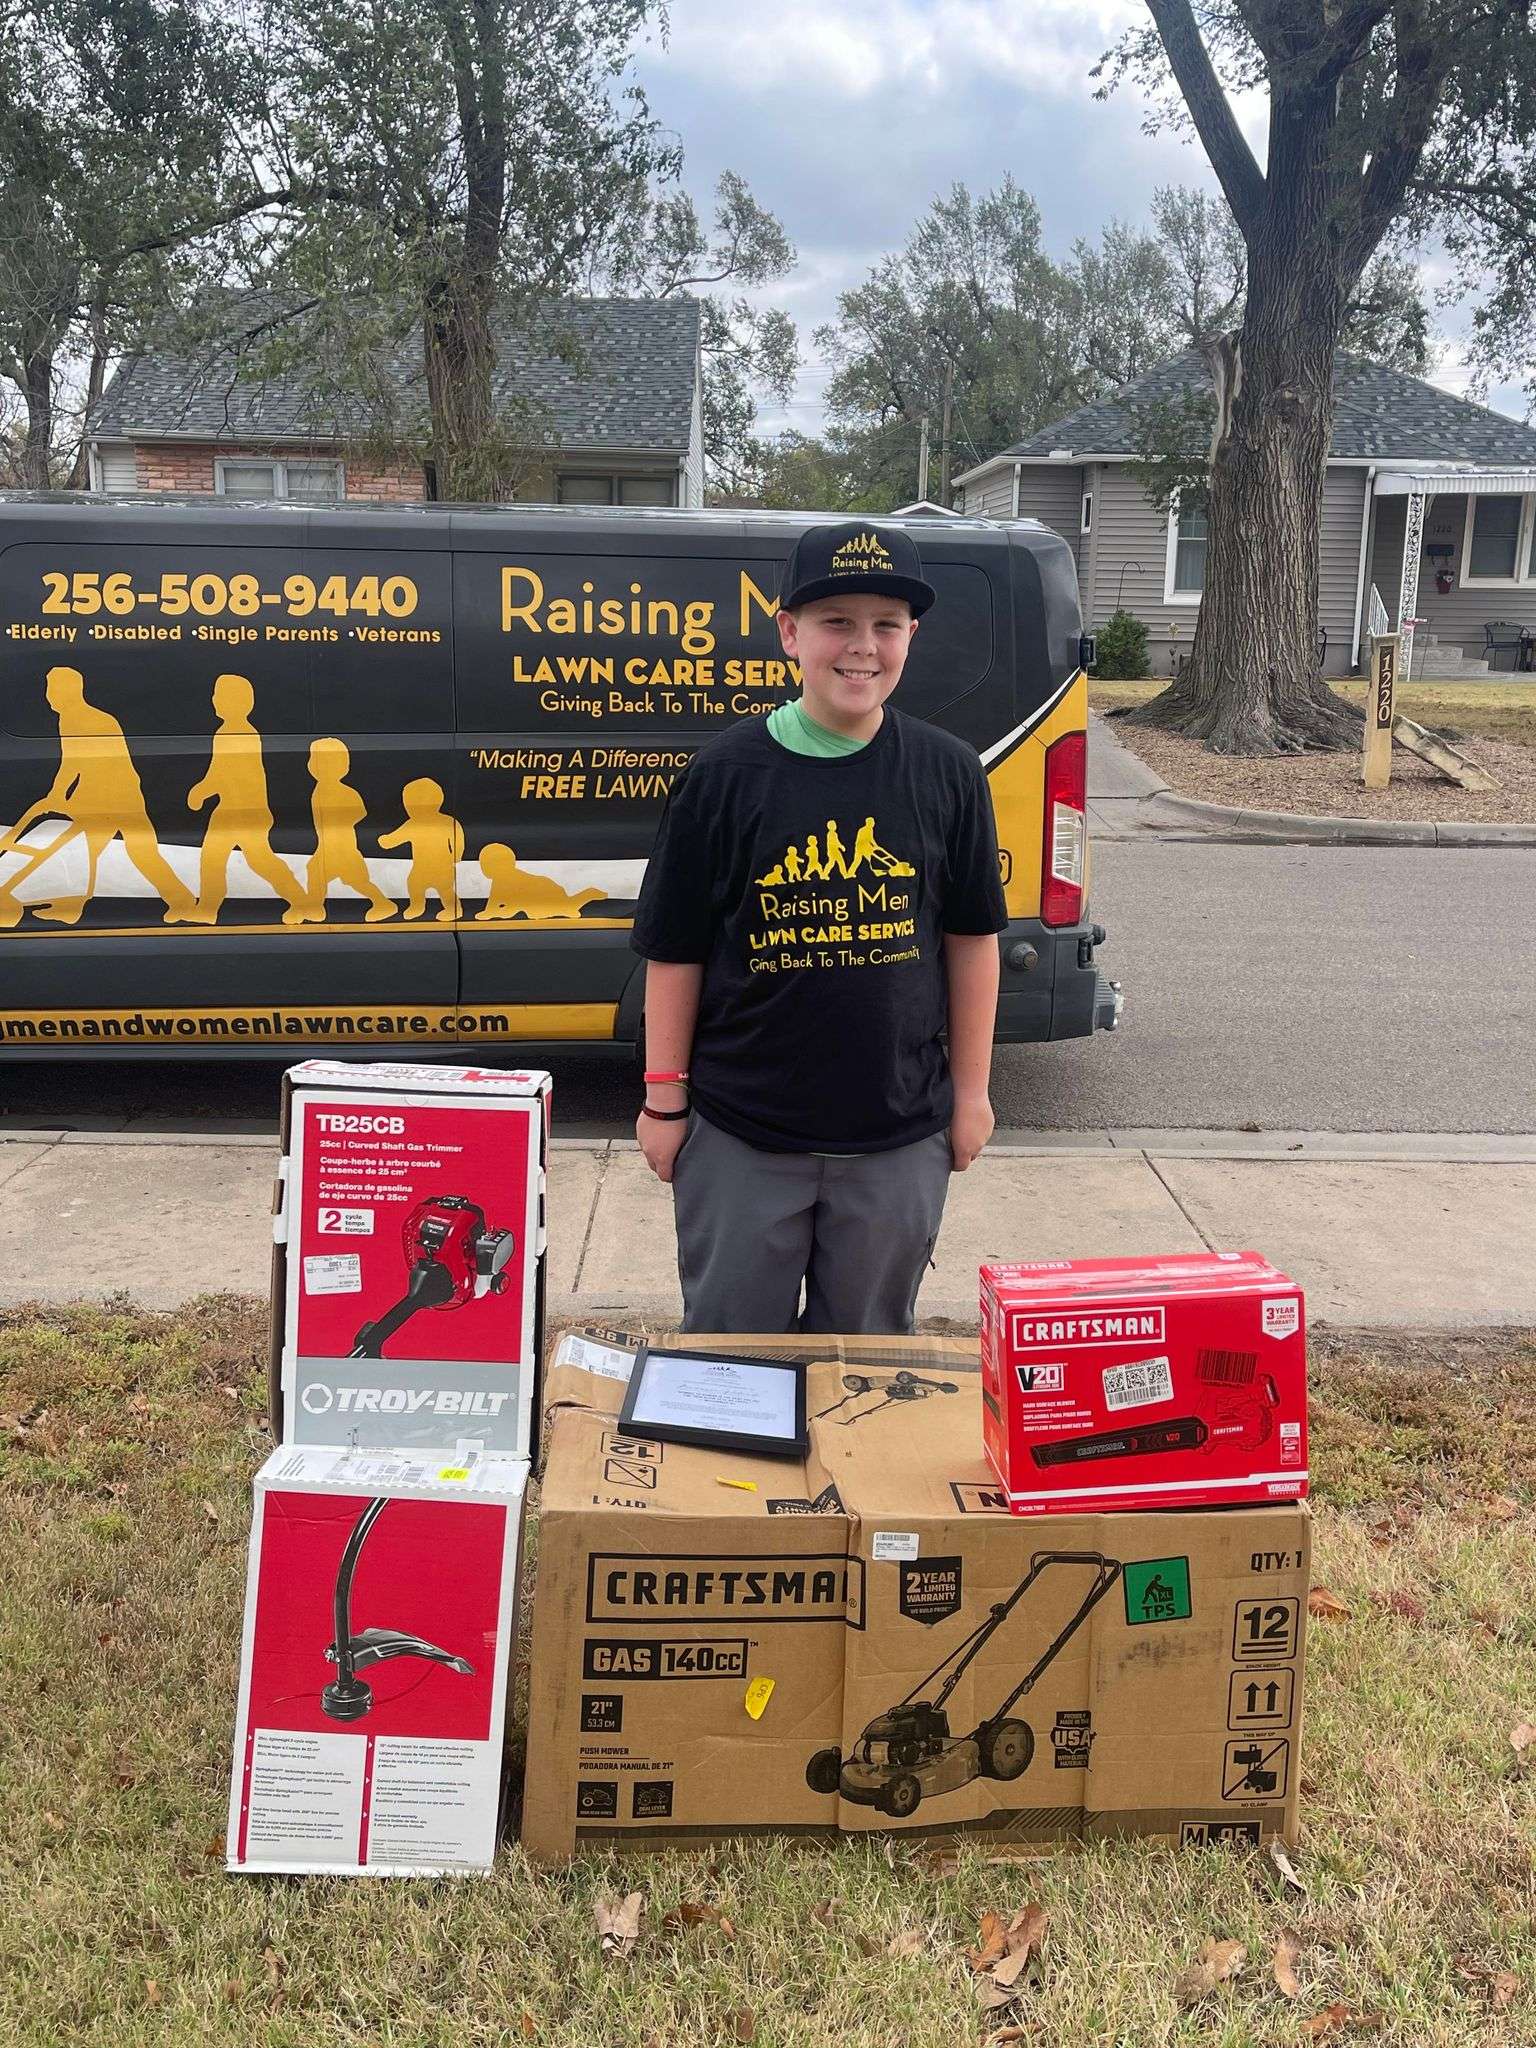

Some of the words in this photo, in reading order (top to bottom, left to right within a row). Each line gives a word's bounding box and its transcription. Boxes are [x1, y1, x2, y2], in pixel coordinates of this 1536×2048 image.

[832, 556, 868, 570] Raising
[871, 556, 893, 570] Men
[41, 572, 419, 617] 256-508-9440
[502, 567, 715, 655] Raising
[266, 627, 339, 642] Parents
[513, 656, 614, 684] LAWN
[624, 658, 715, 686] CARE
[724, 659, 803, 687] SERV
[1378, 654, 1392, 722] 1220
[540, 690, 602, 718] Giving
[609, 691, 655, 713] Back
[660, 692, 683, 713] To
[688, 692, 725, 714] The
[568, 749, 584, 768] A
[520, 775, 586, 798] FREE
[595, 774, 675, 798] LAWN
[760, 892, 849, 922] Raising
[858, 883, 909, 913] Men
[801, 925, 853, 943] CARE
[781, 952, 814, 969] Back
[817, 951, 833, 968] To
[838, 950, 866, 967] The
[0, 1012, 509, 1040] menandwomenlawncare.com
[316, 1114, 405, 1134] TB25CB
[320, 1140, 341, 1149] 25cc
[348, 1140, 380, 1150] Curved
[382, 1141, 405, 1151] Shaft
[407, 1143, 424, 1151] Gas
[426, 1143, 464, 1153] Trimmer
[324, 1210, 341, 1231] 2
[1266, 1307, 1275, 1320] 3
[1275, 1306, 1295, 1314] YEAR
[1022, 1316, 1156, 1342] CRAFTSMAN
[1017, 1366, 1060, 1391] V20
[336, 1388, 510, 1415] TROY-BILT
[1251, 1551, 1290, 1572] QTY:
[1295, 1550, 1302, 1568] 1
[606, 1570, 847, 1605] CRAFTSMA
[906, 1572, 921, 1594] 2
[922, 1572, 956, 1584] YEAR
[924, 1584, 956, 1593] LIMITED
[906, 1592, 956, 1603] WARRANTY
[1142, 1602, 1176, 1619] TPS
[1243, 1605, 1290, 1639] 12
[593, 1647, 651, 1673] GAS
[587, 1718, 603, 1728] 53.3
[1055, 1729, 1091, 1747] USA
[579, 1747, 600, 1755] PUSH
[600, 1747, 630, 1755] MOWER
[578, 1762, 619, 1770] PODADORA
[619, 1762, 651, 1770] MANUAL
[651, 1762, 661, 1770] DE
